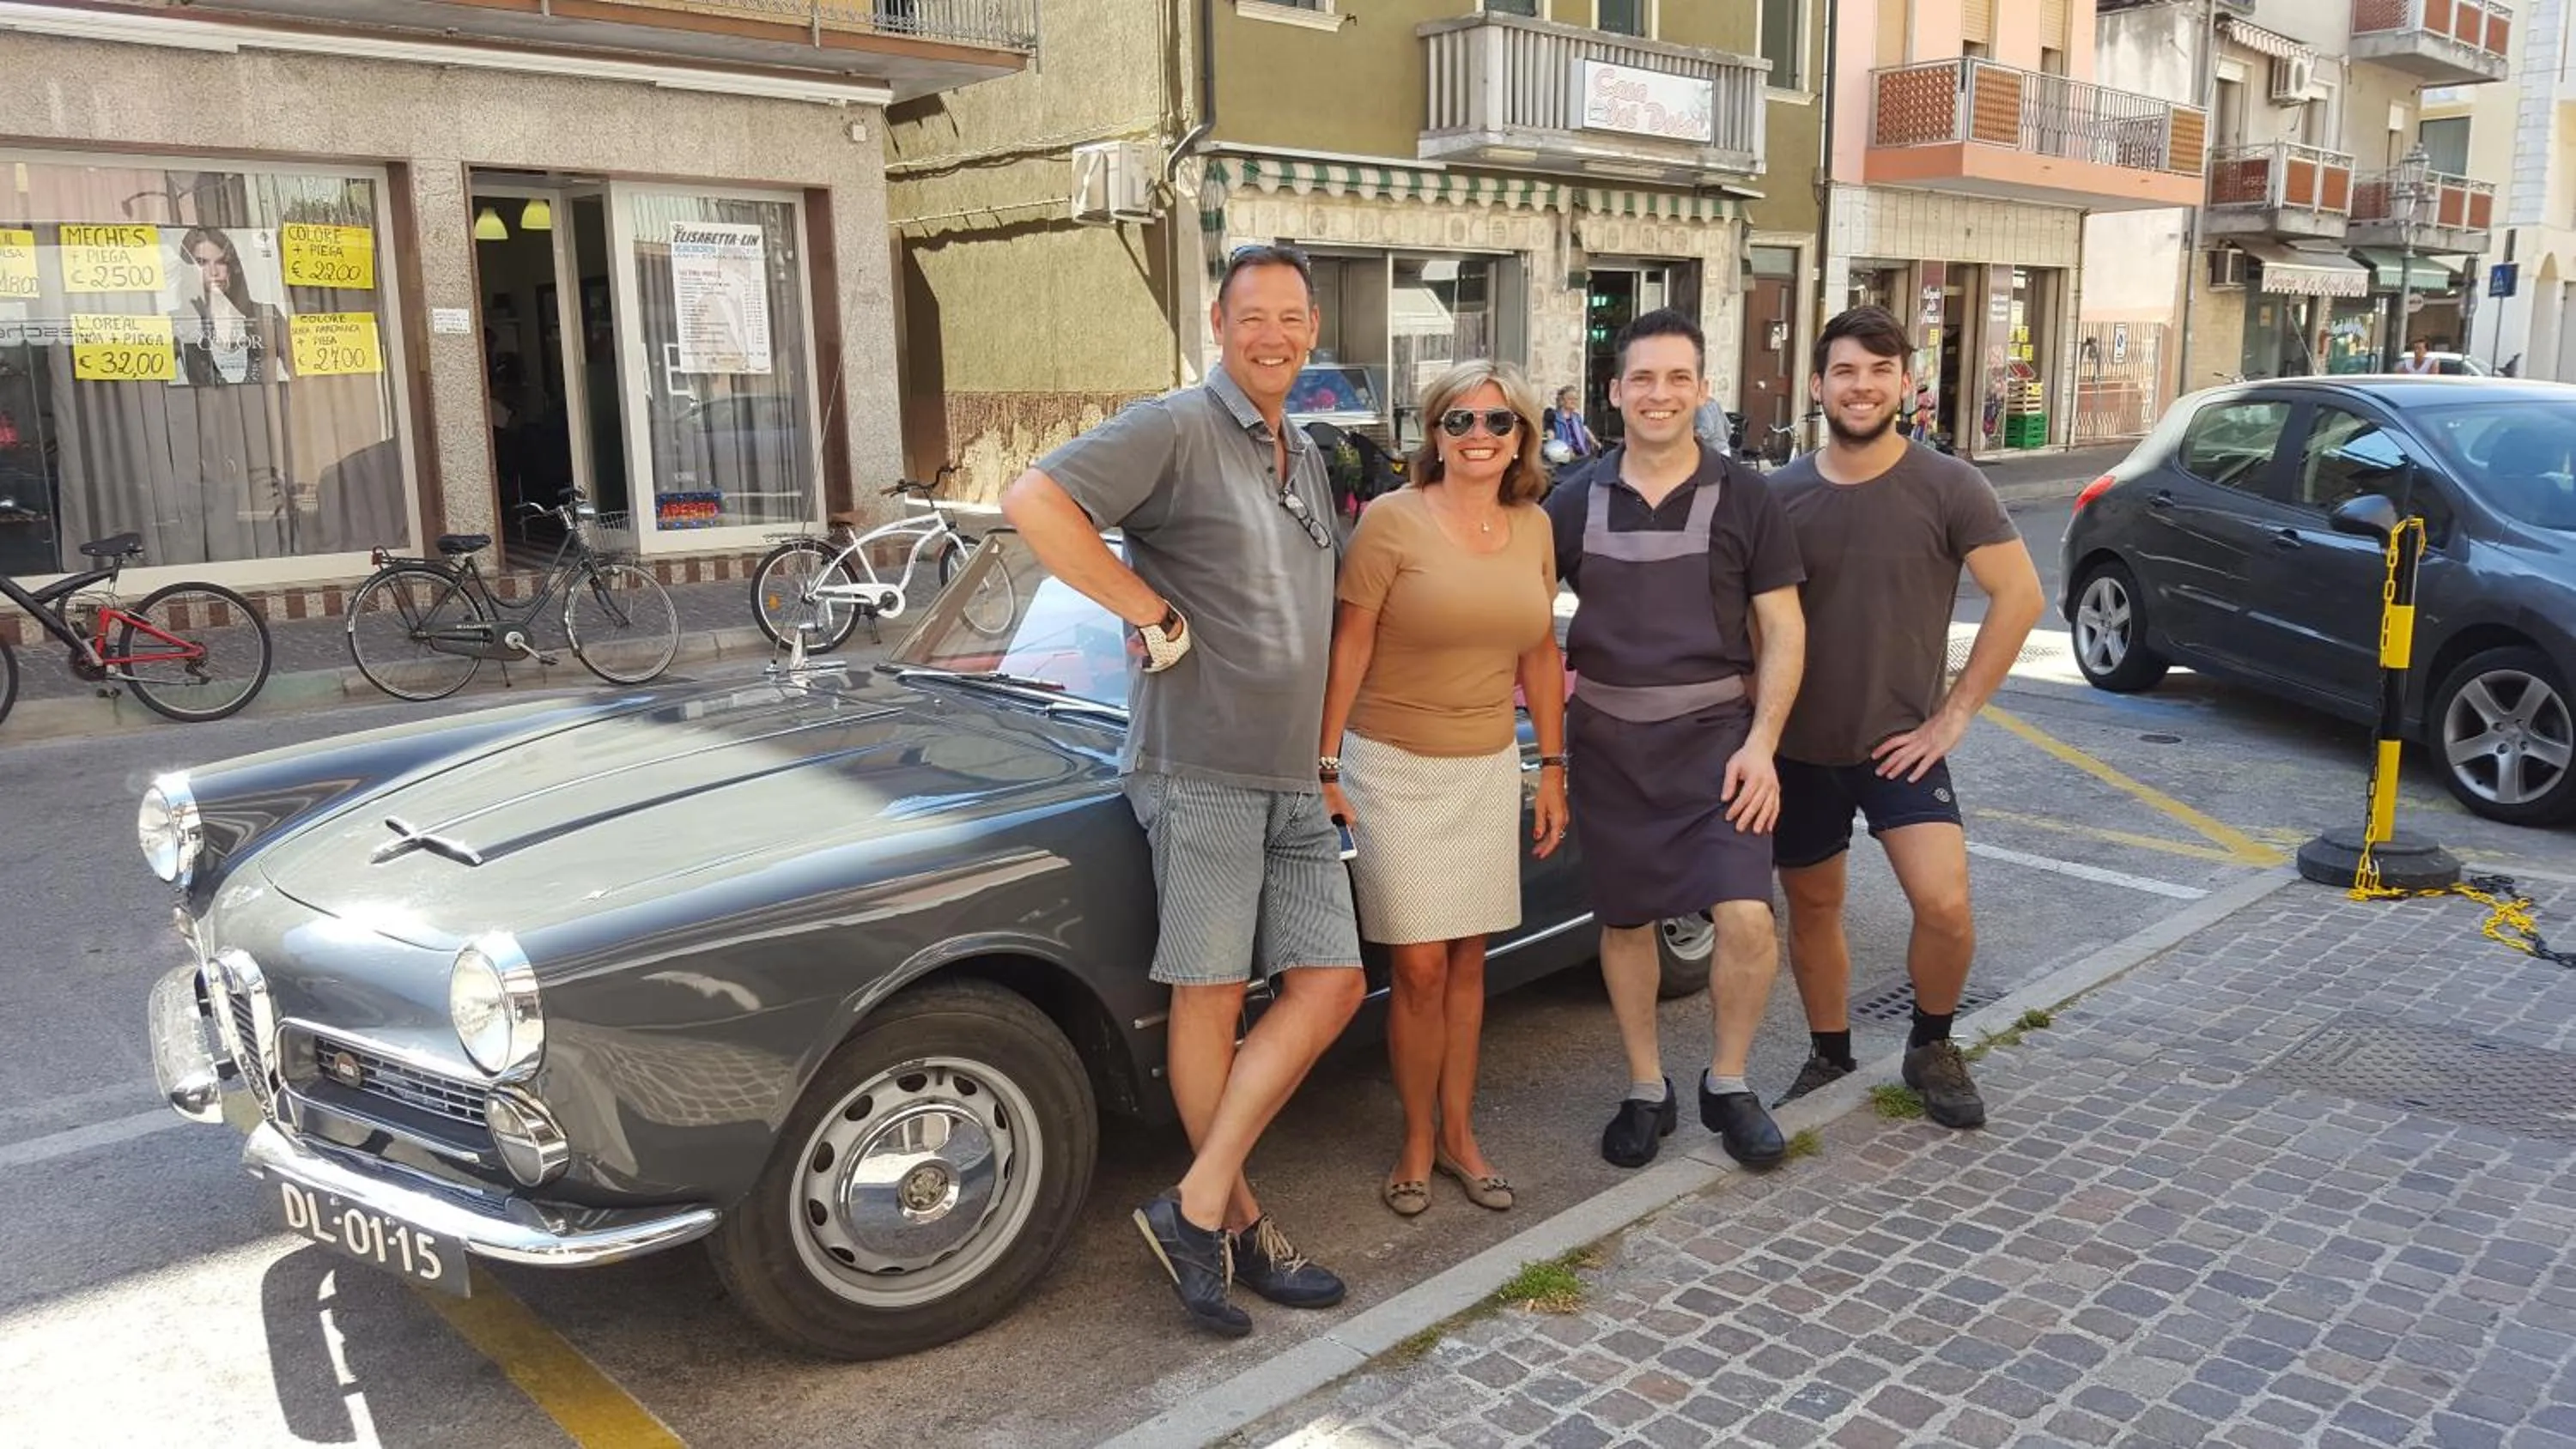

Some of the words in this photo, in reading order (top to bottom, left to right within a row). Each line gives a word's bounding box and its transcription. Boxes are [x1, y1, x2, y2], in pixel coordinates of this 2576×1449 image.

[67, 227, 149, 247] MECHES
[288, 226, 342, 244] COLORE
[87, 249, 131, 264] PIEGA
[310, 243, 344, 258] PIEGA
[300, 314, 348, 324] COLORE
[123, 333, 165, 346] PIEGA
[100, 351, 165, 378] 32,00
